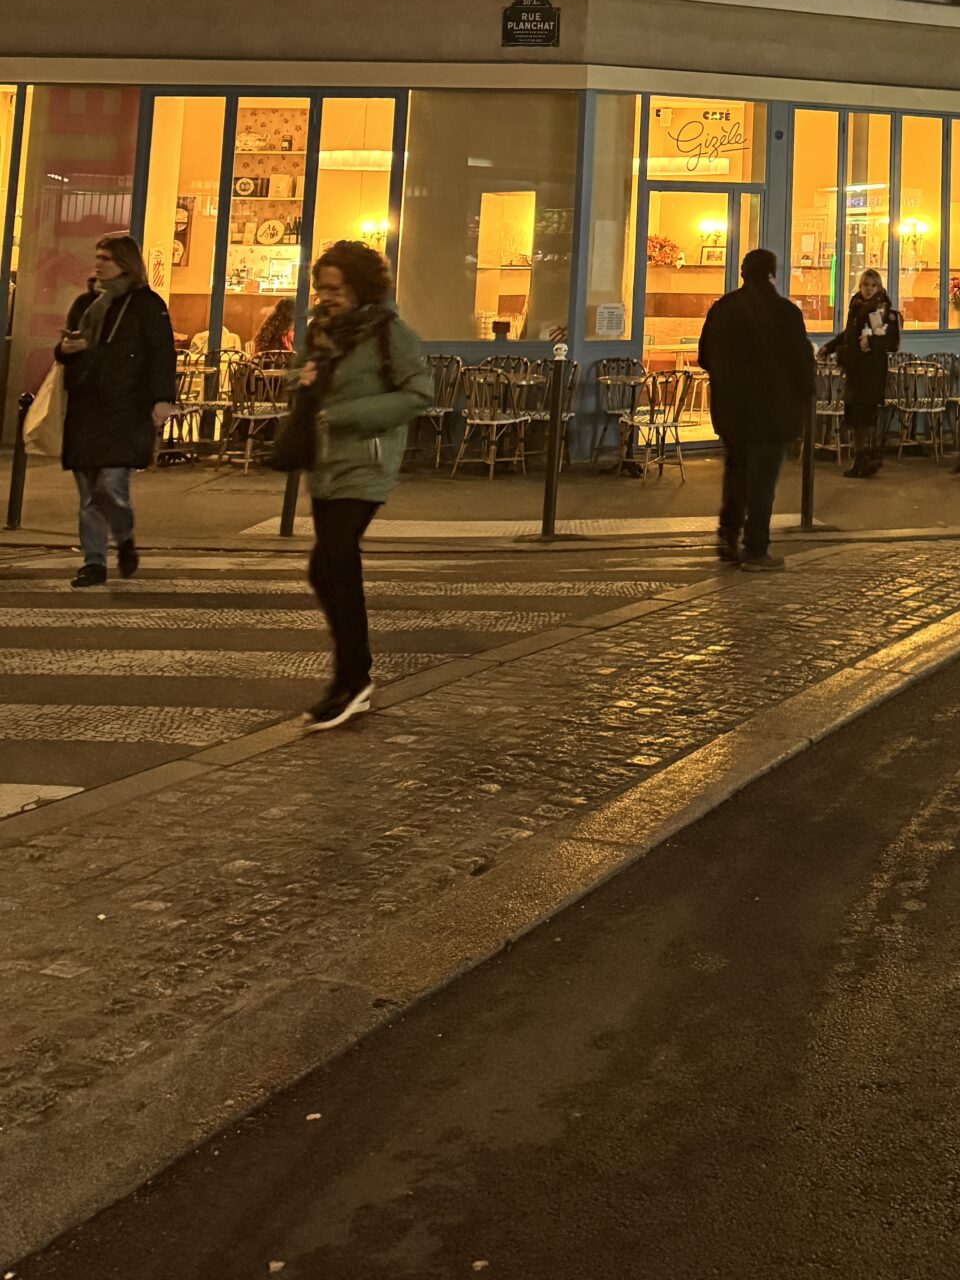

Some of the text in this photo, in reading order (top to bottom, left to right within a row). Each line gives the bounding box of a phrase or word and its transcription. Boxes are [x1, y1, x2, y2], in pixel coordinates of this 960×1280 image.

[521, 12, 541, 20] RUE
[507, 21, 555, 30] PLANCHAT
[702, 109, 731, 121] CAFÉ
[667, 120, 749, 171] Gizèle
